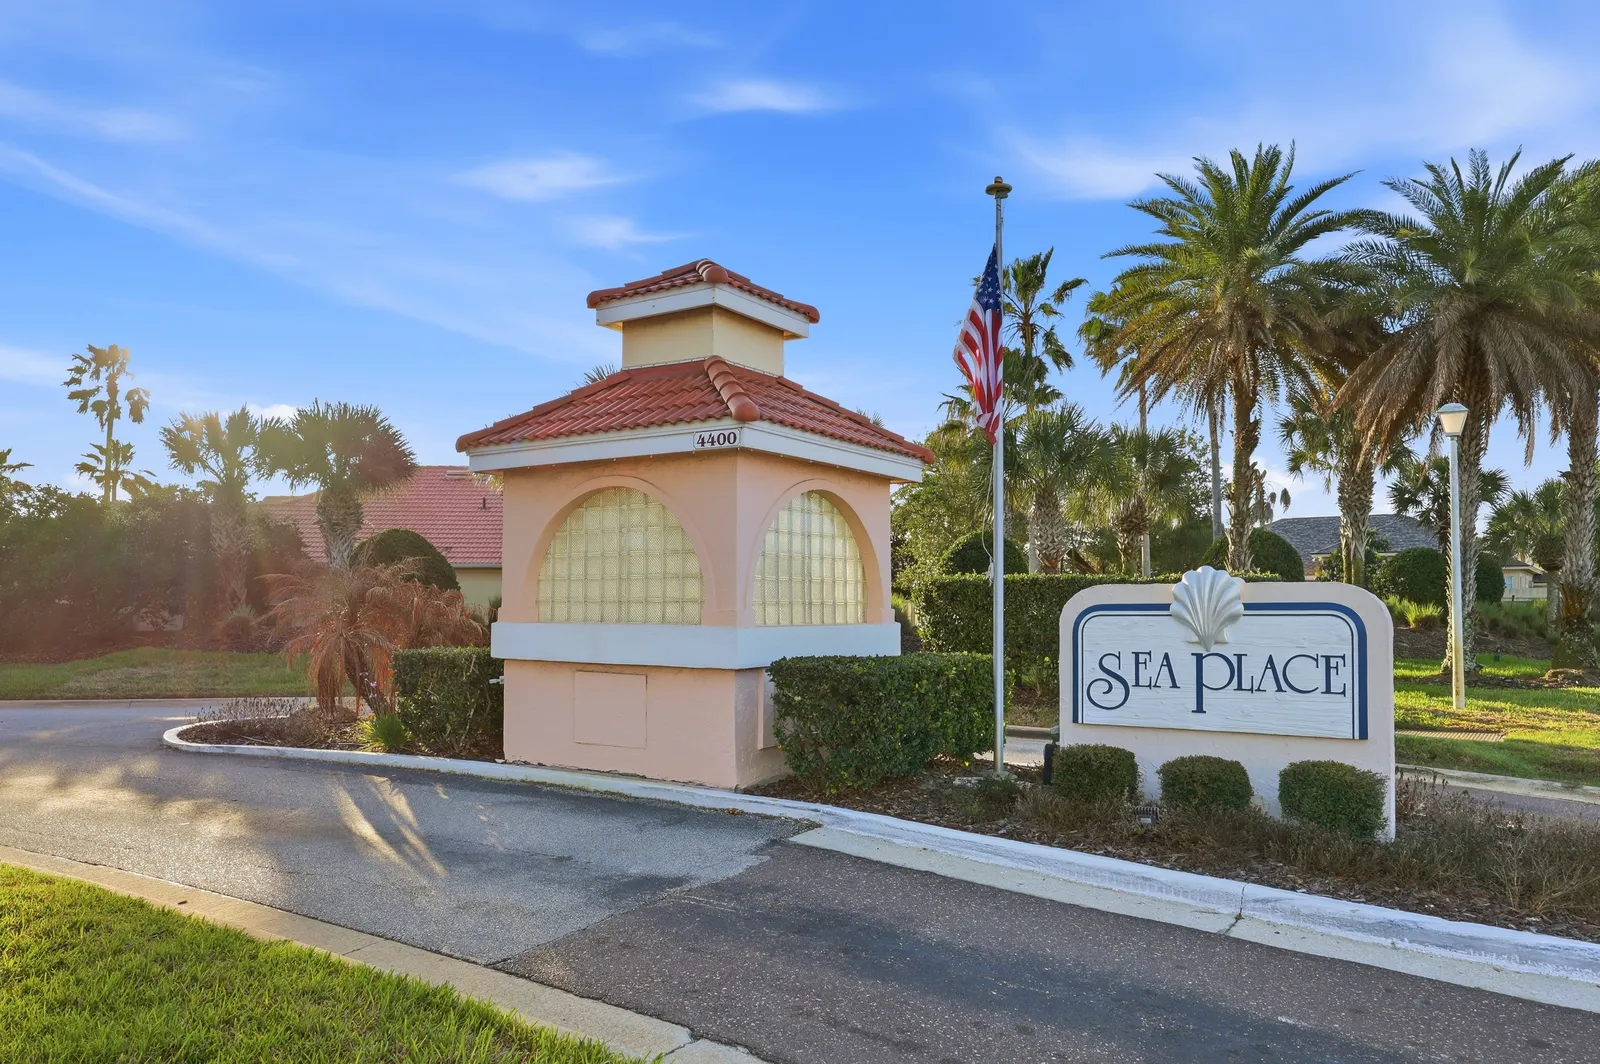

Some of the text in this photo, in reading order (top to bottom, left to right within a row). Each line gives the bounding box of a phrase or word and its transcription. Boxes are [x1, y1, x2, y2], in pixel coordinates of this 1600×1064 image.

[696, 431, 737, 447] 4400
[1086, 650, 1347, 714] SEA PLACE
